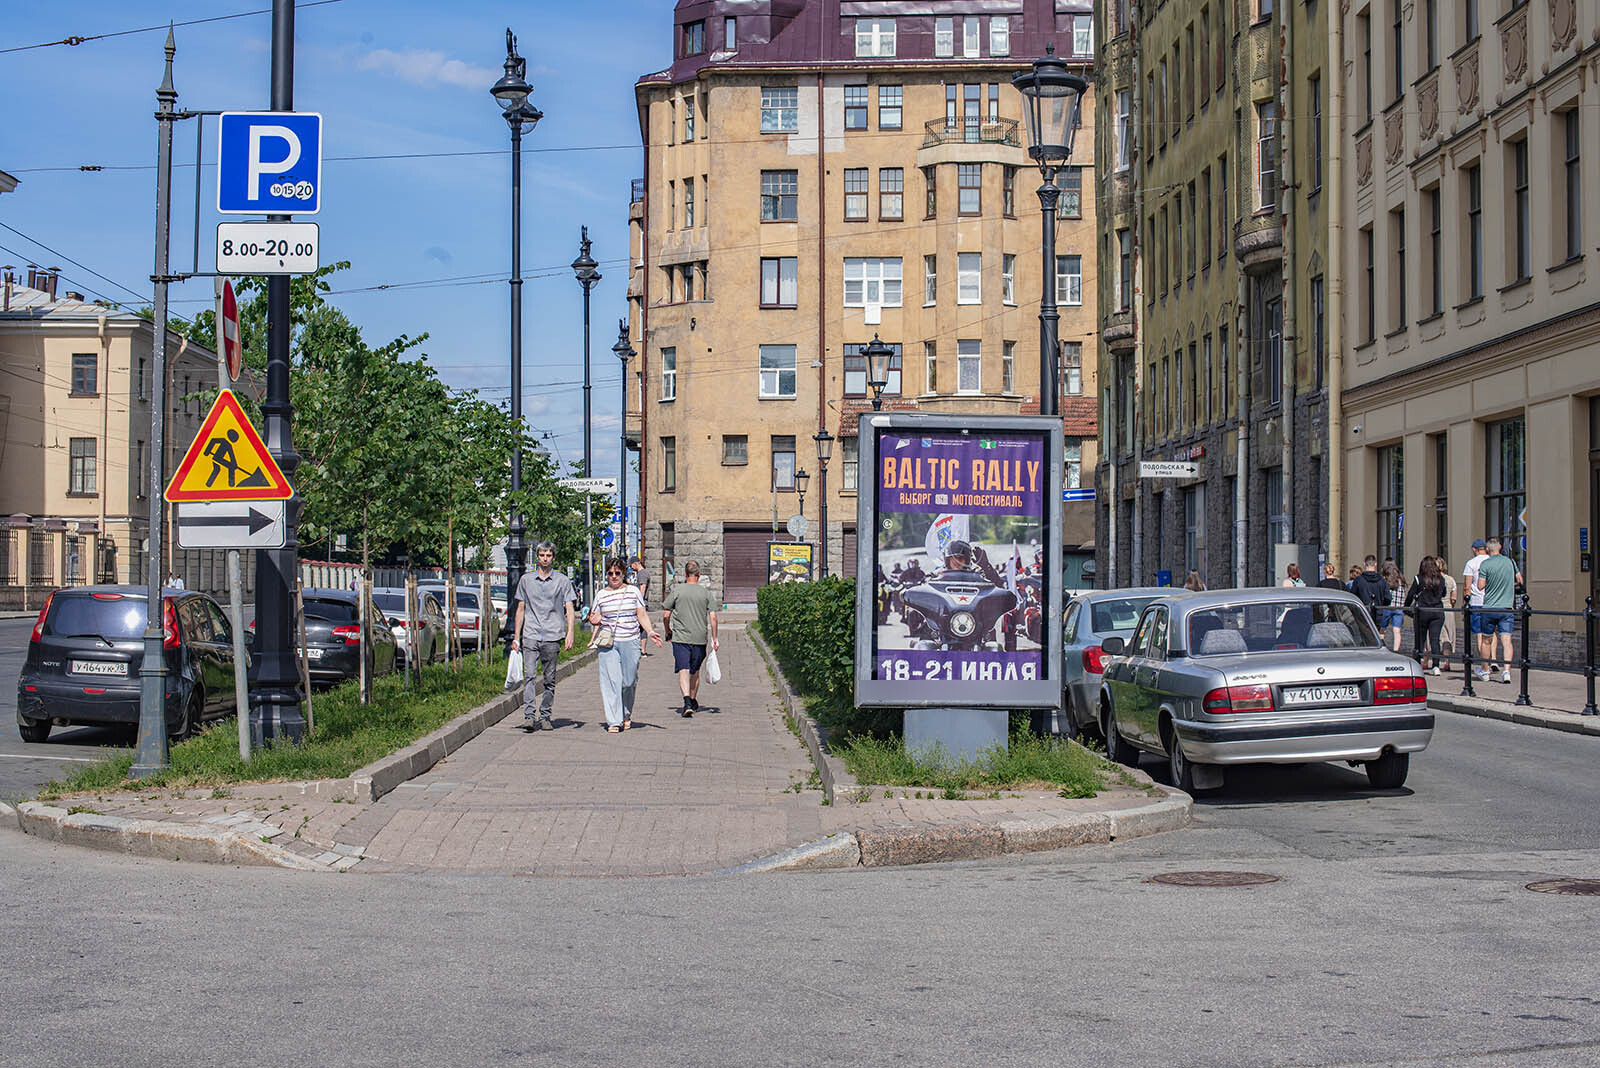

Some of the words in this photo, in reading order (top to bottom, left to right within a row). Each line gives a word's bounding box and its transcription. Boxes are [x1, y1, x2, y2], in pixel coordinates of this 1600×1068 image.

[248, 125, 301, 200] P
[284, 186, 294, 194] 15
[297, 185, 312, 196] 20
[222, 239, 313, 256] 8.00-20.00
[883, 456, 960, 489] BALTIC
[900, 492, 932, 505] ВЫБОРГ
[952, 493, 1023, 507] МОТОФЕСТИВАЛЬ
[881, 659, 953, 680] 18-21
[961, 661, 1037, 680] ИЮЛЯ
